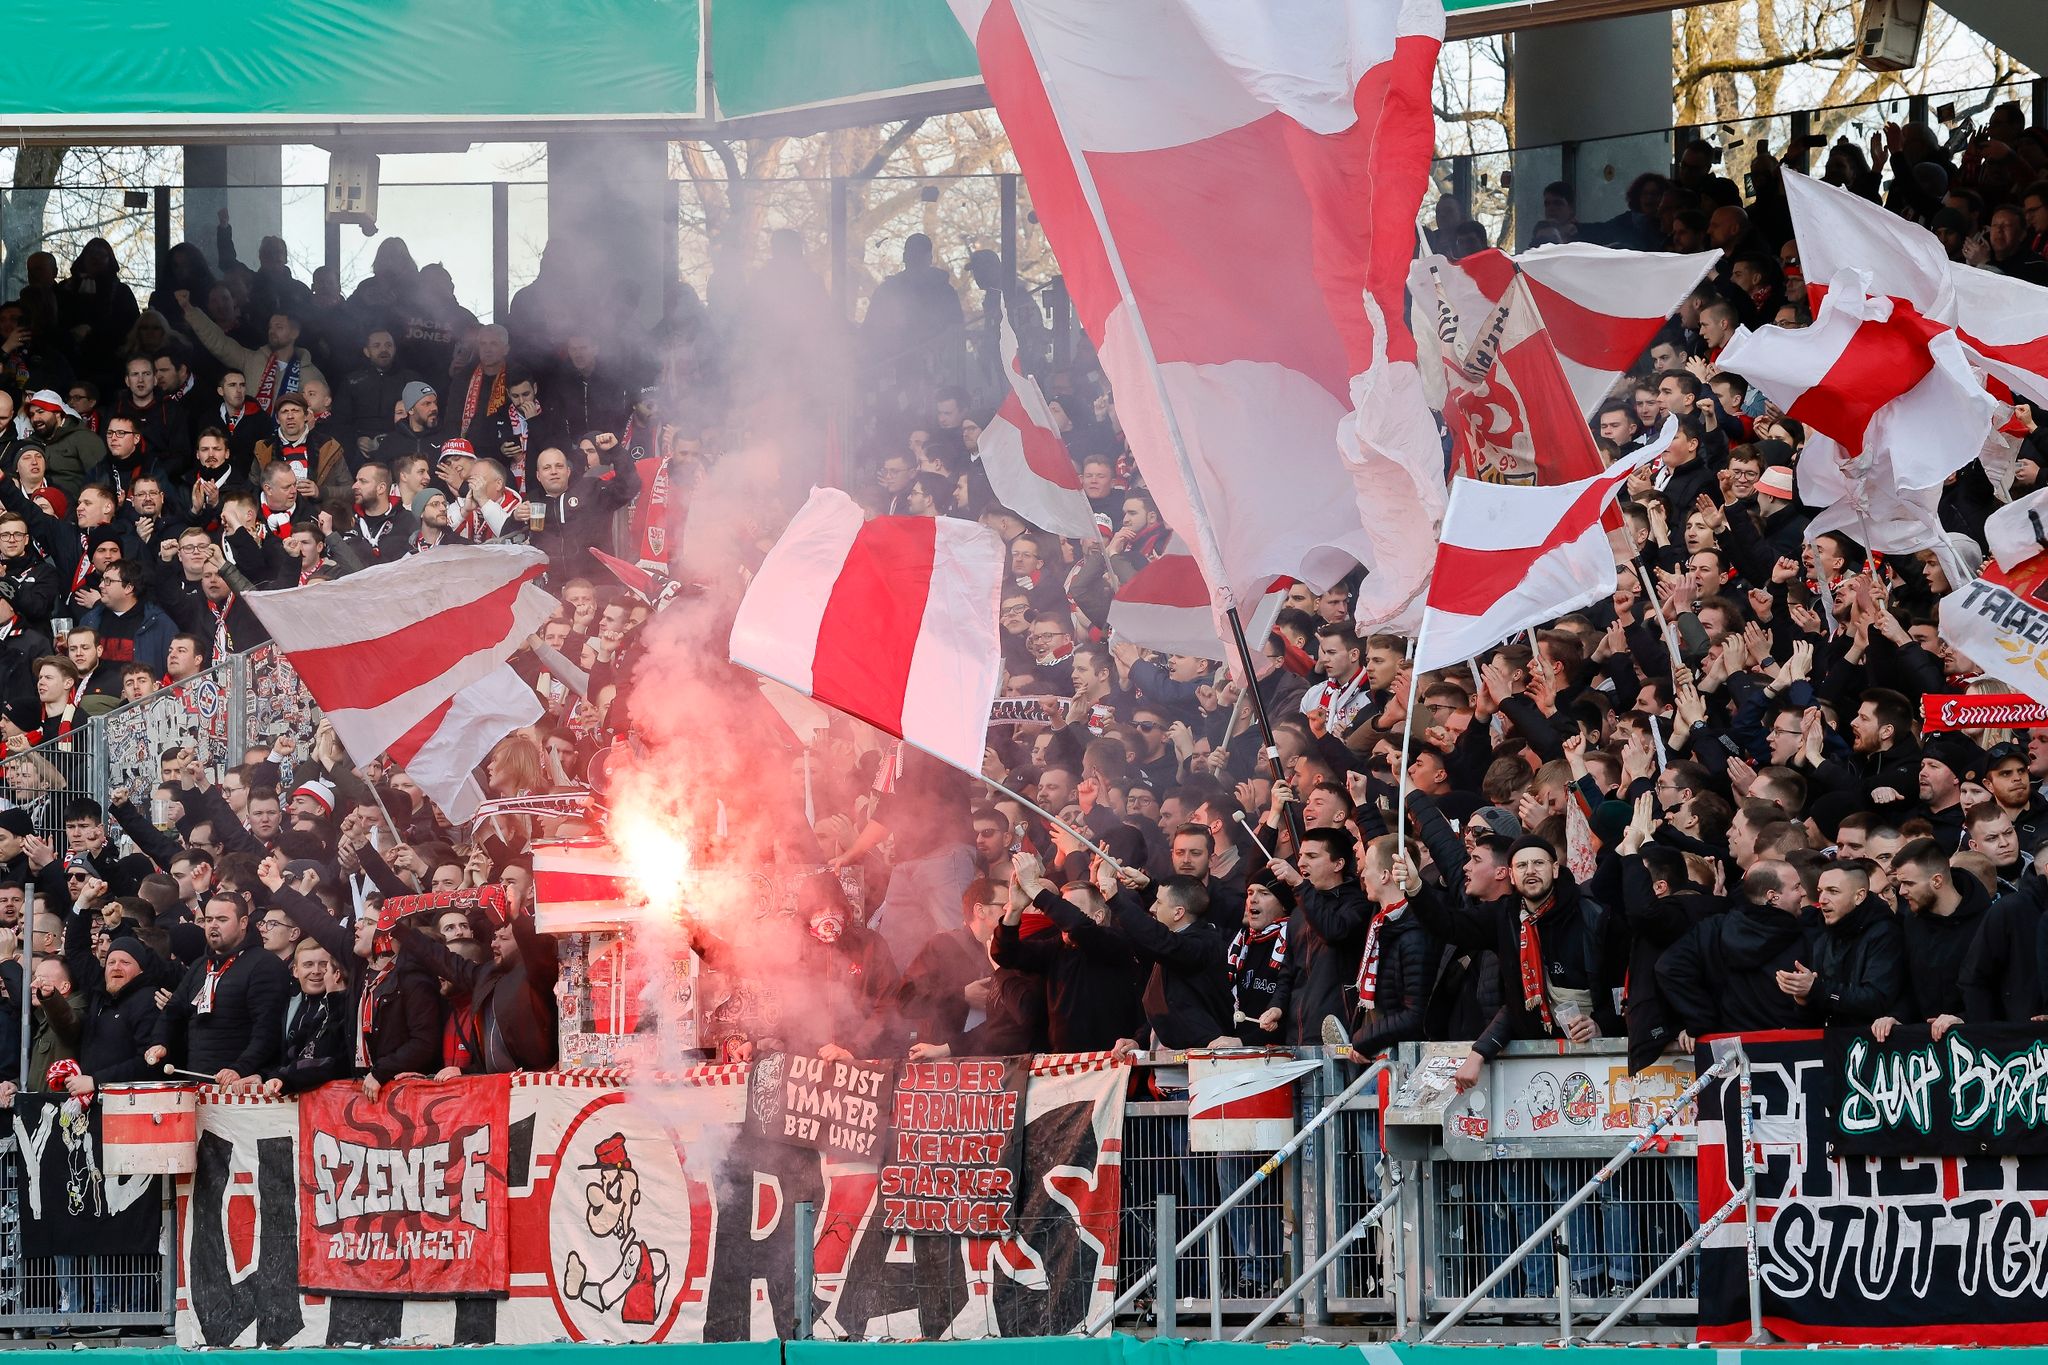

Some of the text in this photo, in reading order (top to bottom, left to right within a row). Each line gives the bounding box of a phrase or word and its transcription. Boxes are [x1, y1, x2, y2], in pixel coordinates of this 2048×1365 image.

[406, 329, 450, 343] JONES
[790, 1055, 885, 1097] DU BIST
[899, 1062, 1005, 1092] JEDER
[786, 1081, 878, 1130] IMMER
[784, 1114, 877, 1156] BEI UNS!
[898, 1132, 1005, 1164] KEHRT
[313, 1124, 490, 1231] SZENE E
[881, 1164, 1014, 1199] STÄRKER
[884, 1198, 1012, 1234] ZURÜCK
[1760, 1199, 2048, 1299] STUTTG
